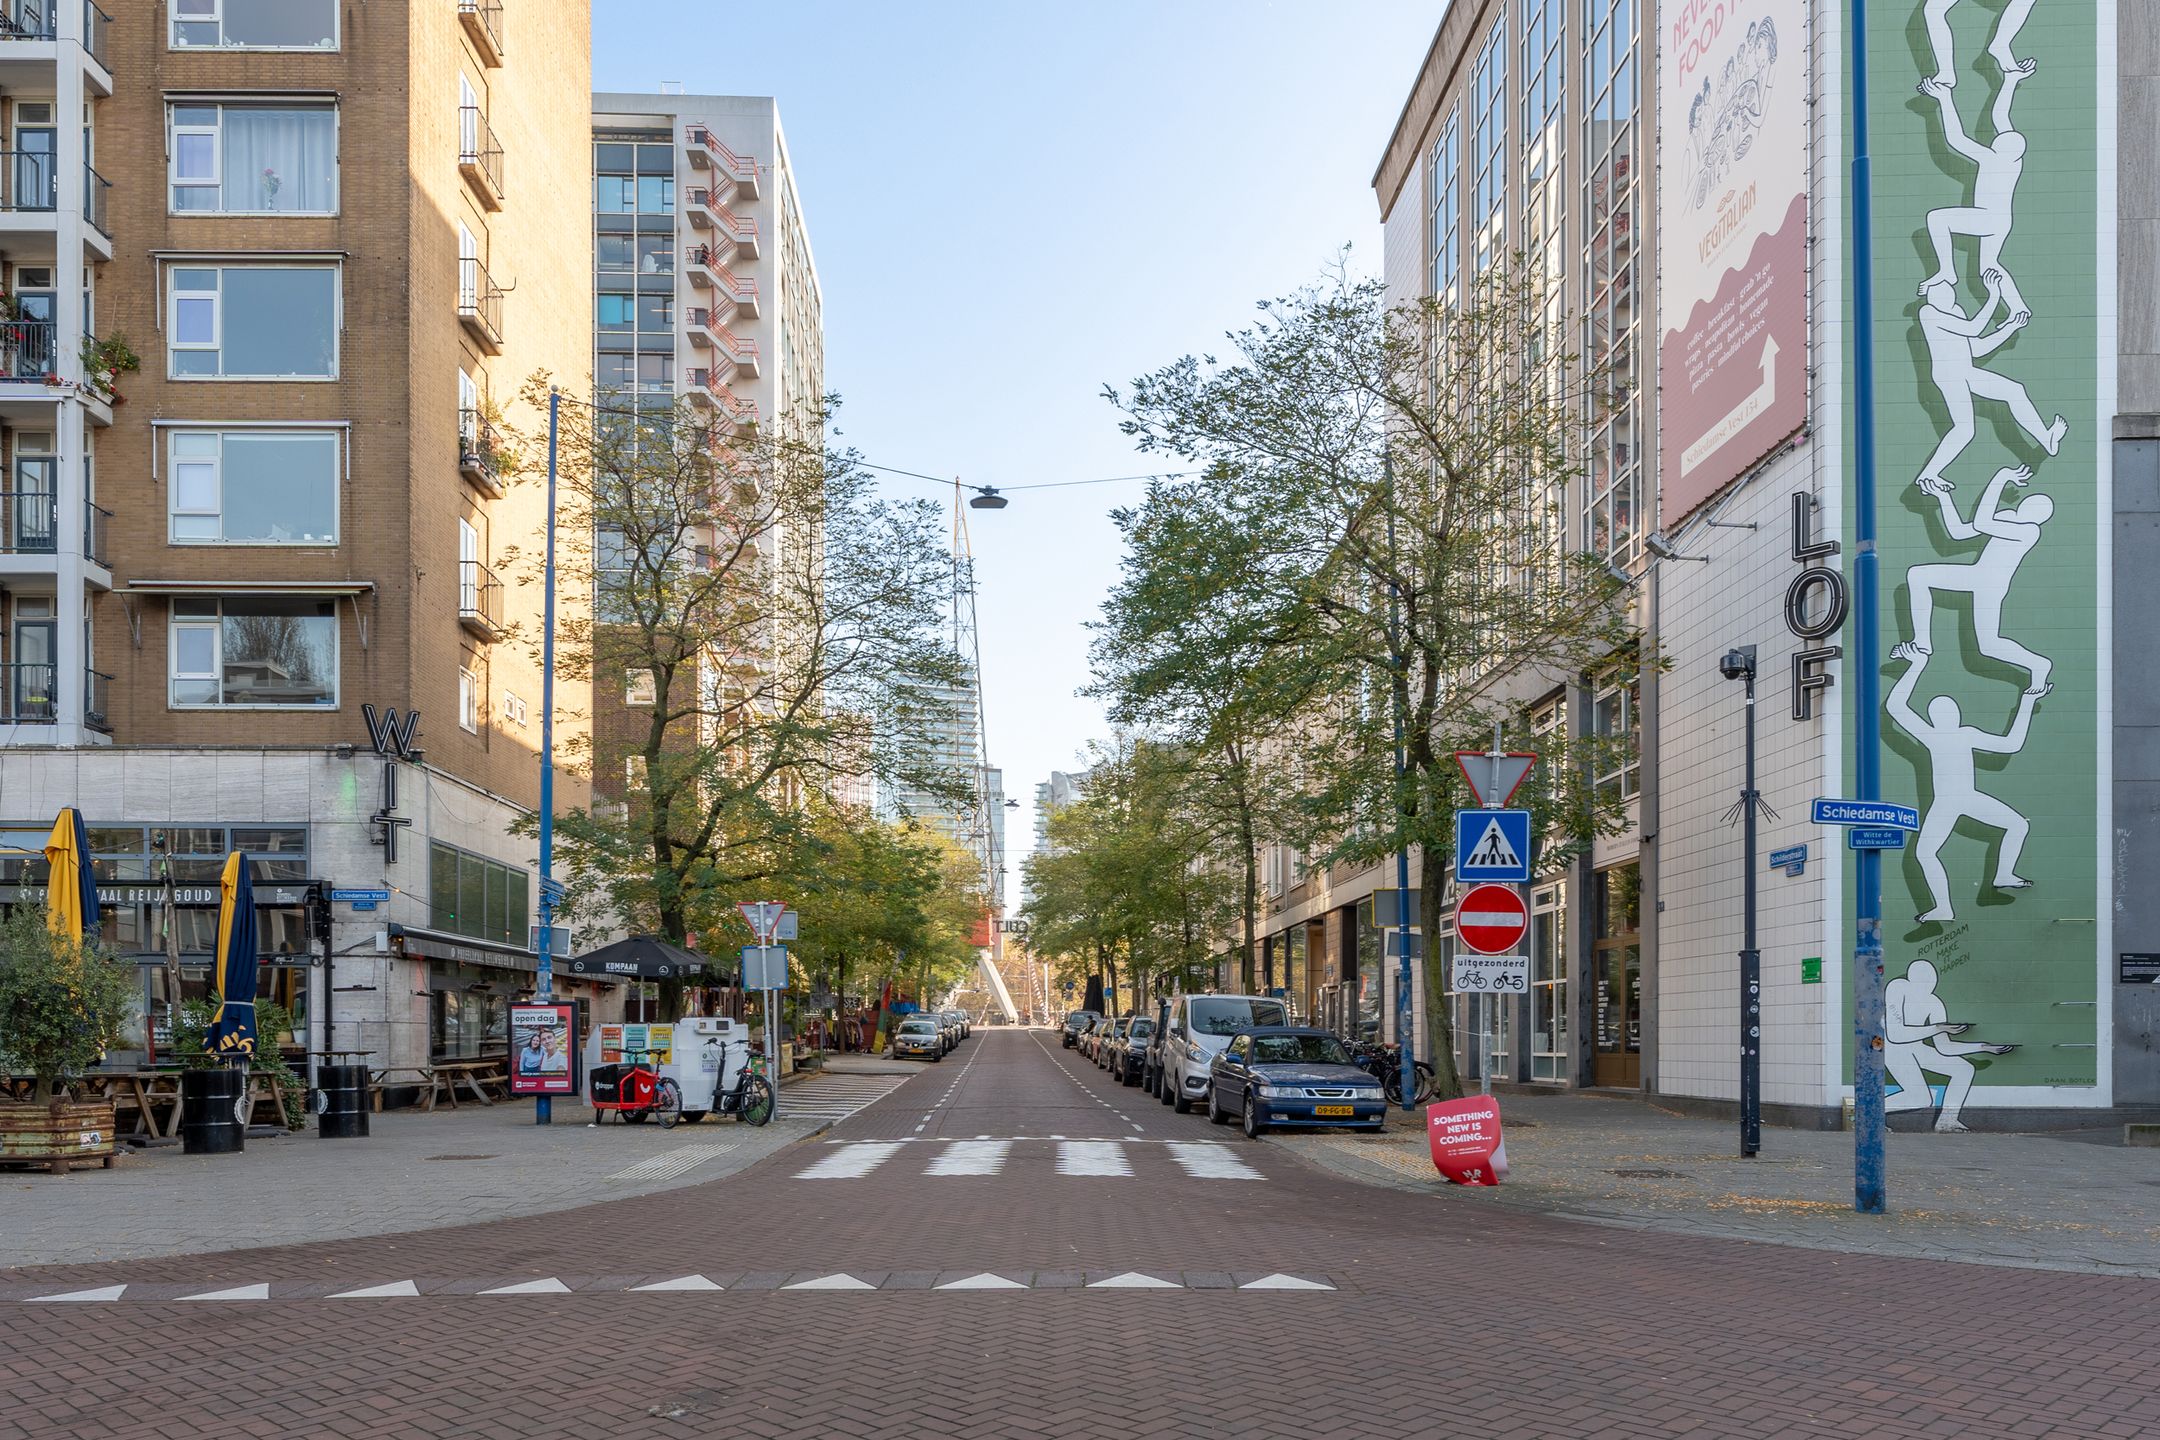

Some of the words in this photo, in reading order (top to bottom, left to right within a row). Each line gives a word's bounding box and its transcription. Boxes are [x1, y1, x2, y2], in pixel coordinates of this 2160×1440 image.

[1679, 3, 1724, 88] FOOD
[1698, 180, 1757, 264] VEGITALIAN
[1687, 329, 1704, 350] coffee
[1708, 297, 1735, 330] breakfast
[1740, 278, 1754, 301] grab
[1762, 262, 1771, 279] go
[1685, 349, 1701, 368] wraps
[1705, 314, 1735, 348] neapolitan
[1740, 275, 1774, 314] homemade
[1689, 360, 1704, 382] pizza
[1708, 342, 1723, 364] pasta
[1749, 297, 1769, 320] vegan
[1691, 367, 1714, 395] pastries
[1718, 337, 1741, 368] mindful
[1742, 318, 1765, 345] choices
[1784, 490, 1849, 721] LOF
[361, 703, 420, 863] WIT
[1822, 804, 1895, 822] Schiedamse
[1897, 810, 1916, 826] Vest
[128, 889, 212, 902] REIJGOUD
[1918, 923, 1969, 957] ROTTERDAM
[1936, 941, 1960, 960] MAKE
[605, 962, 638, 972] KOMPAAN
[1457, 959, 1525, 968] uitgezonderd
[1939, 952, 1970, 975] HAPPEN
[515, 1015, 536, 1023] open
[537, 1014, 555, 1023] dag
[1433, 1110, 1494, 1126] SOMETHING
[1447, 1123, 1470, 1134] NEW
[1472, 1122, 1482, 1131] IS
[1440, 1132, 1492, 1145] COMING...
